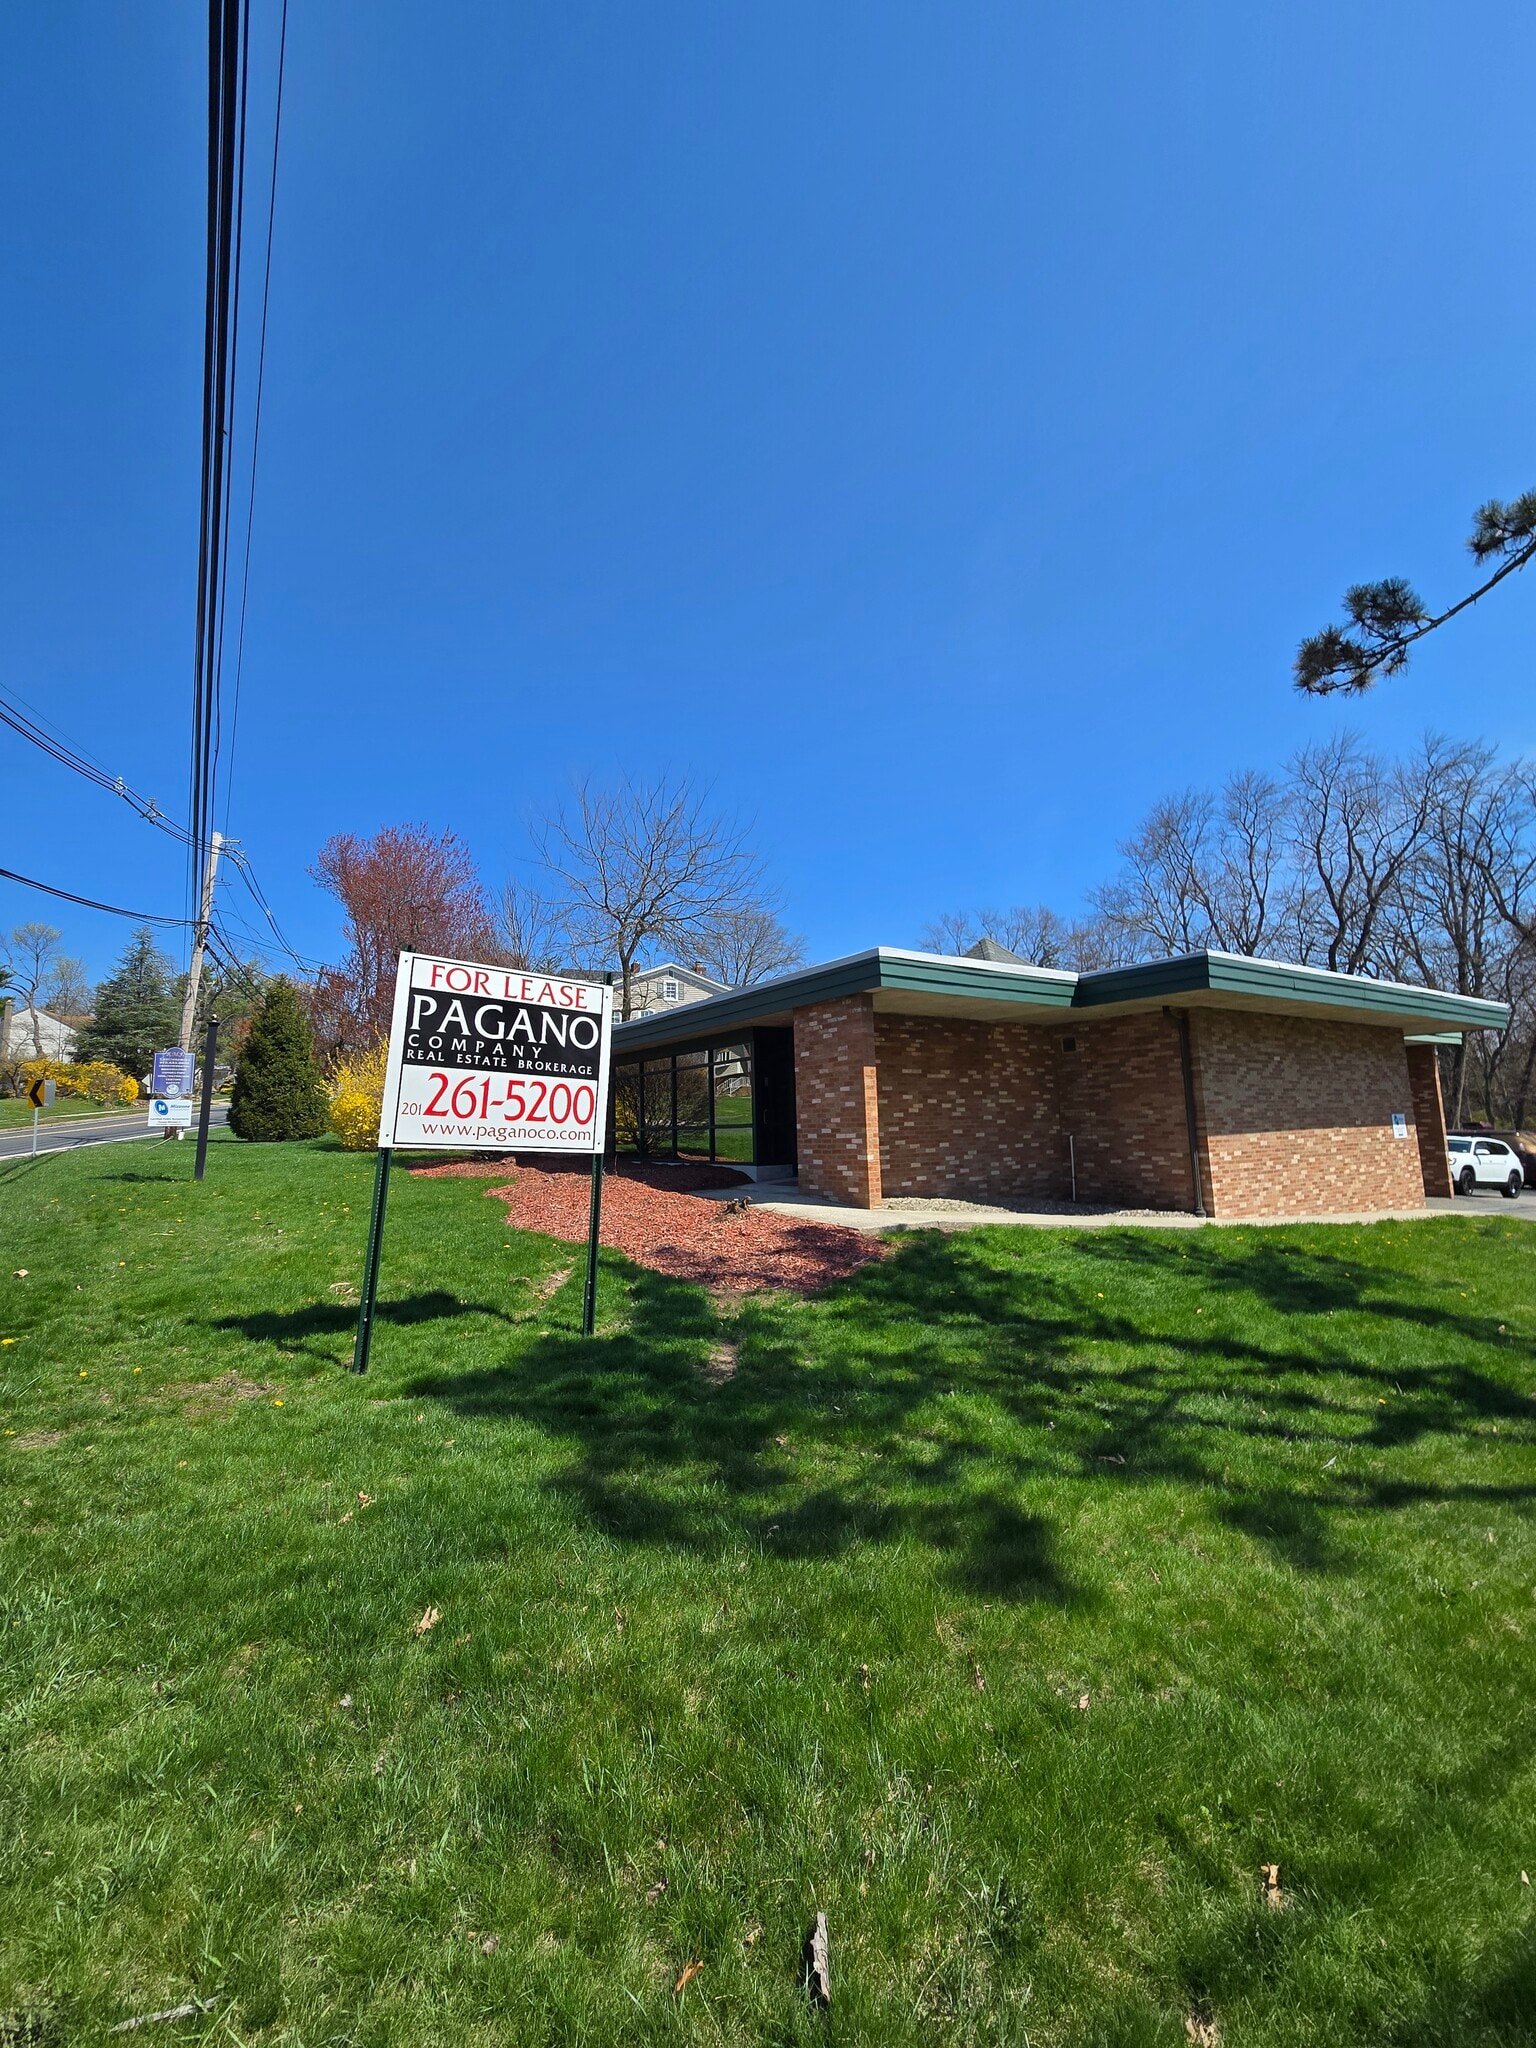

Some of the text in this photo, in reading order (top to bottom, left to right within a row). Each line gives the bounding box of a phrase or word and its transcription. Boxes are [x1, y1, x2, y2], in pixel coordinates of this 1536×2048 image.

[430, 965, 587, 1009] FOR LEASE
[410, 994, 599, 1049] PAGANO
[407, 1049, 593, 1075] REAL ESTATE BROKERAGE
[408, 1034, 542, 1059] COMPANY
[401, 1073, 594, 1125] 201 261-5200
[422, 1123, 591, 1142] www.paganoco.com
